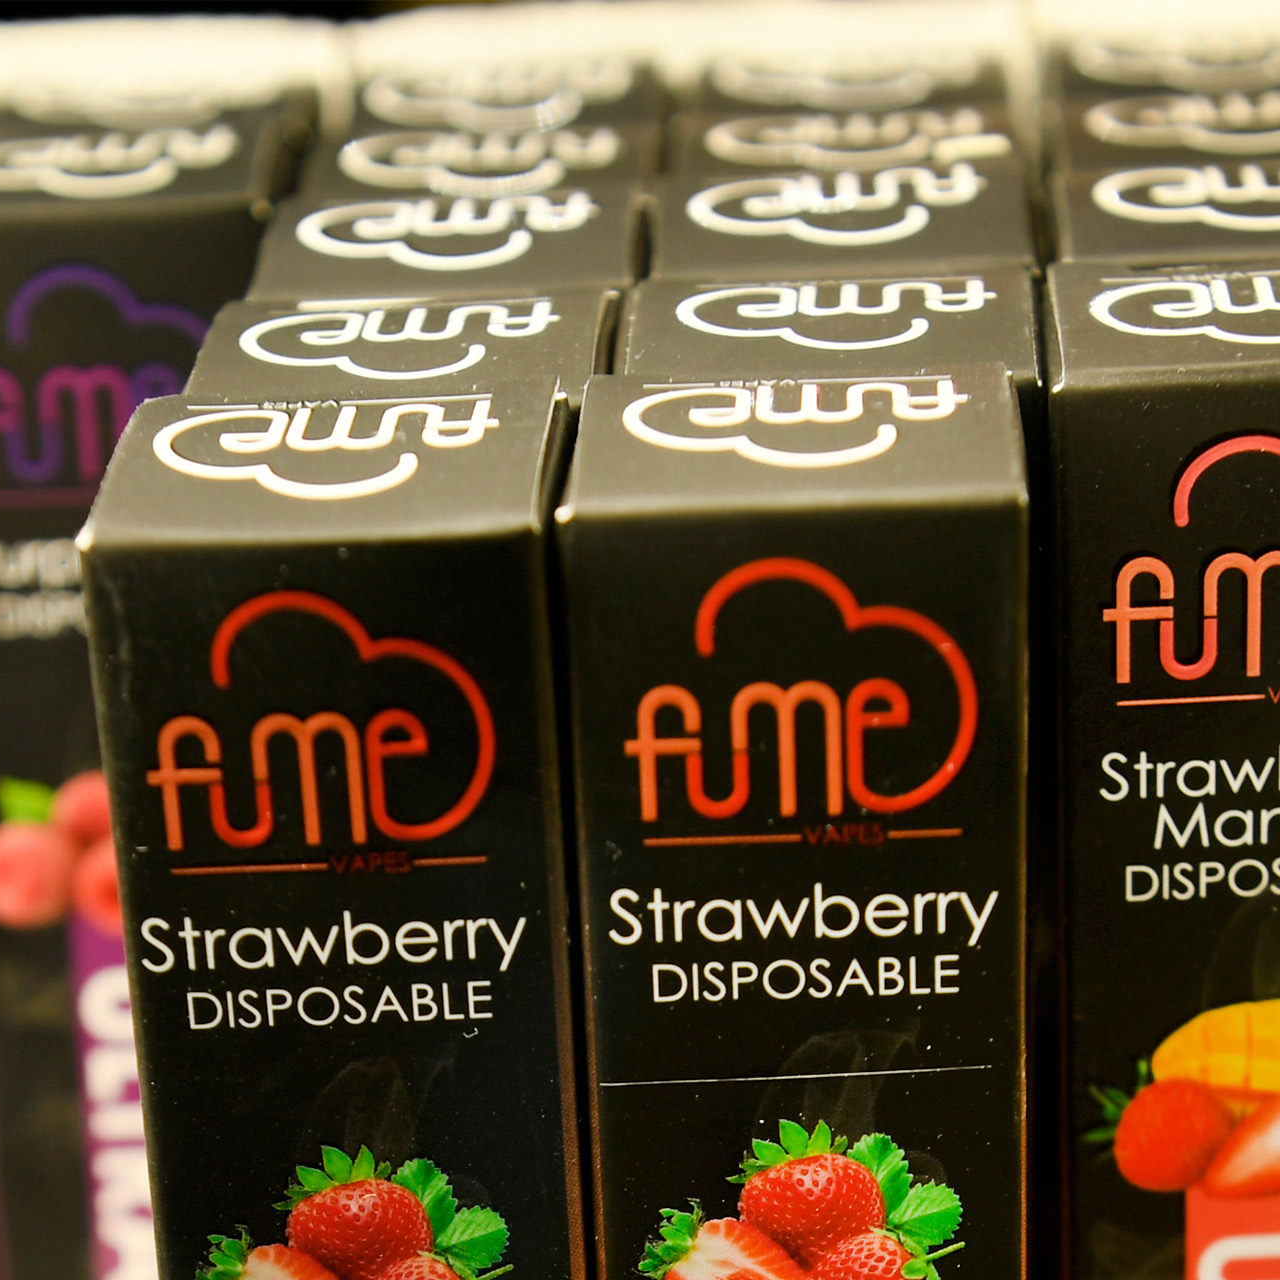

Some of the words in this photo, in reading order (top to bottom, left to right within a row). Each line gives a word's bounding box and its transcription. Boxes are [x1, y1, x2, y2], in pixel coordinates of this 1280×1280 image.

[801, 821, 887, 847] VAPES
[326, 850, 411, 875] VAPES
[608, 882, 999, 948] Strawberry
[140, 910, 527, 976] Strawberry
[652, 953, 960, 1003] DISPOSABLE
[187, 979, 494, 1031] DISPOSABLE
